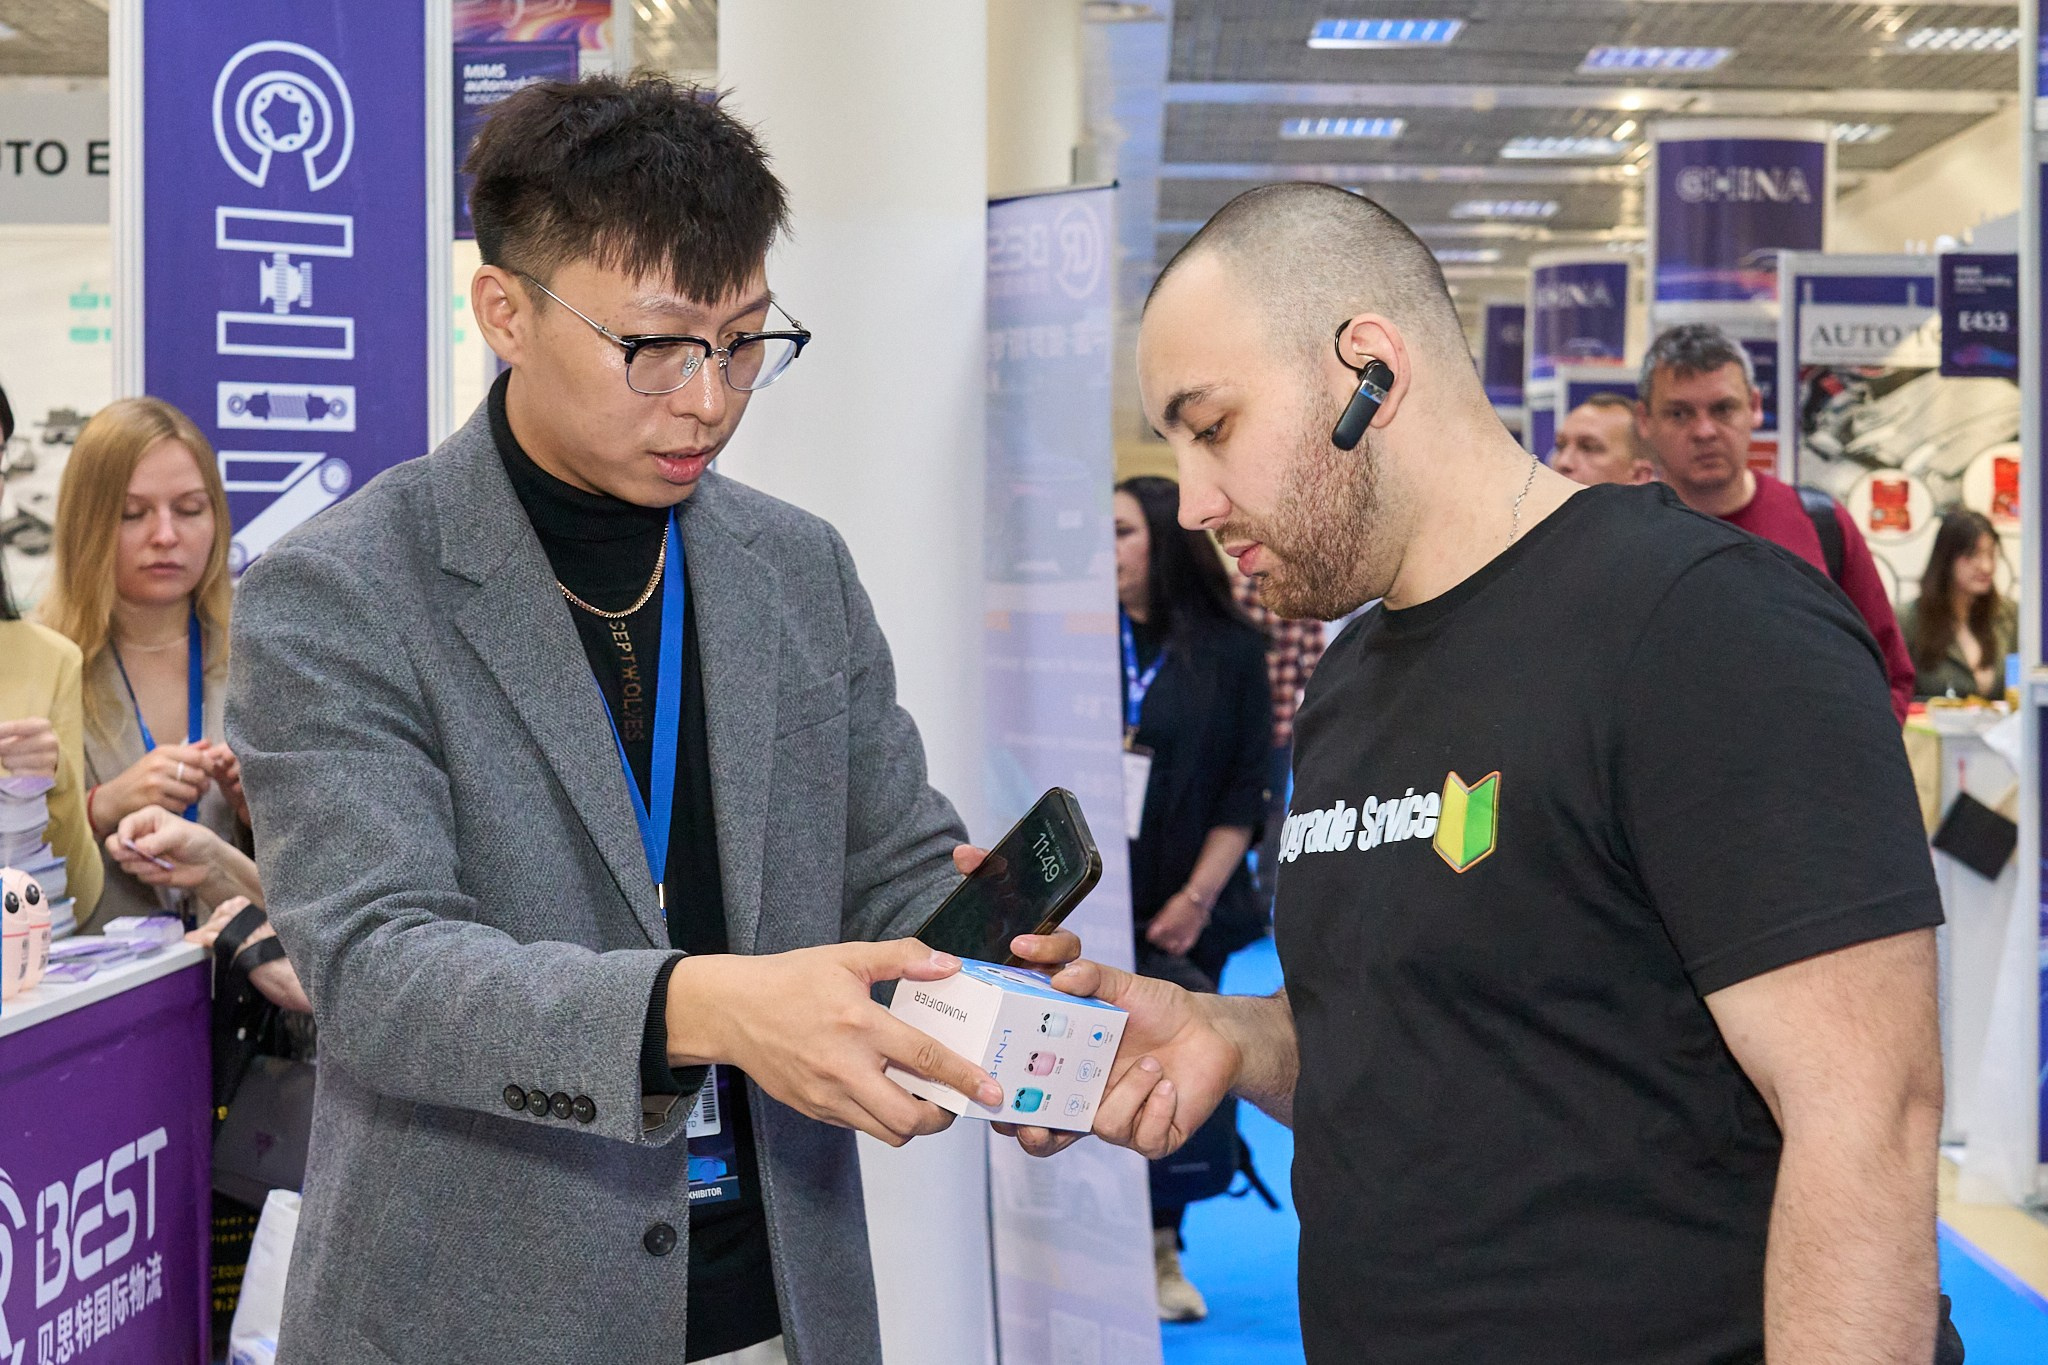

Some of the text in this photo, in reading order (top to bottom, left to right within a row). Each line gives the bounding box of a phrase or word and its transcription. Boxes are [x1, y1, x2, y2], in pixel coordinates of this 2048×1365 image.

[463, 63, 507, 79] MIMS
[0, 141, 68, 175] TO
[1675, 166, 1811, 203] CHINA
[212, 40, 356, 585] CHIN
[1958, 311, 2009, 332] E433
[1810, 323, 1902, 347] AUTO
[1357, 787, 1440, 851] Service
[1032, 832, 1060, 883] 11:49
[914, 990, 968, 1023] HUMIDIFIER
[688, 1187, 722, 1200] XHIBITOR
[36, 1126, 168, 1310] BEST
[37, 1251, 163, 1365] 贝思特国际物流
